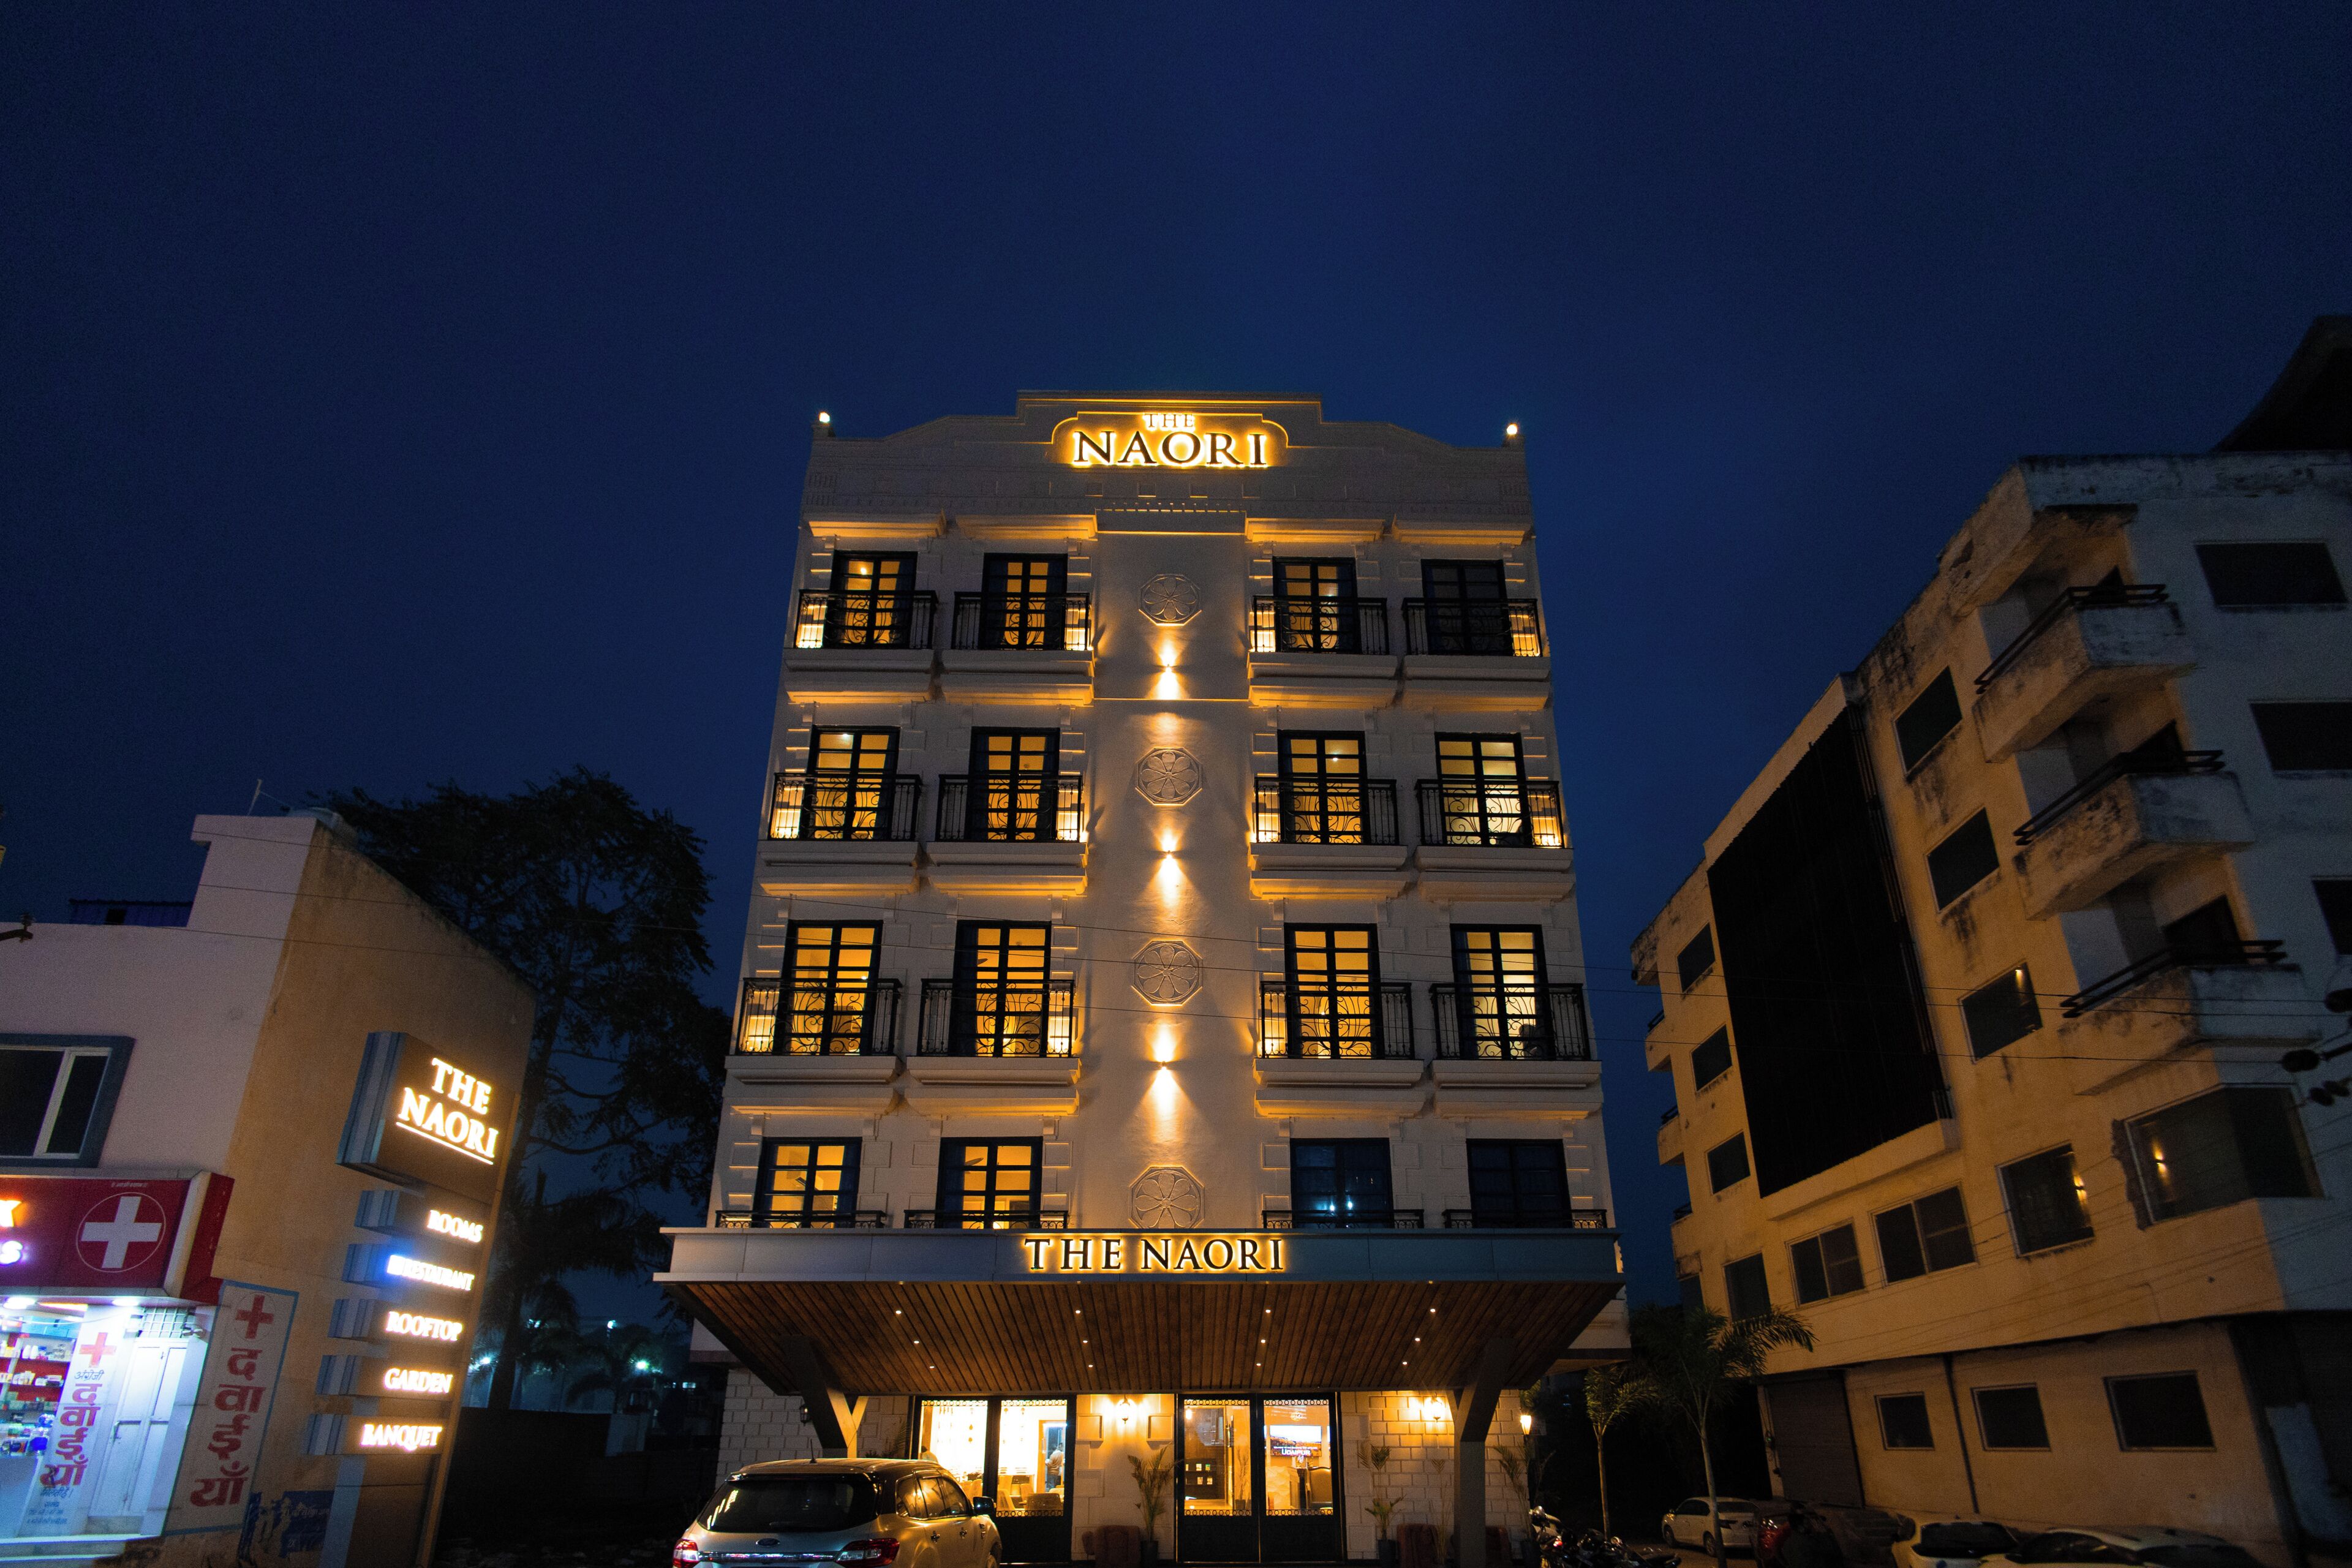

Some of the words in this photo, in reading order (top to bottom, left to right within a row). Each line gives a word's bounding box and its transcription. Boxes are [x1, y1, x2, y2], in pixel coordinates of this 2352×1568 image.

[1143, 412, 1196, 429] THE
[1072, 430, 1268, 467] NAORI
[431, 1057, 492, 1115] THE
[398, 1087, 499, 1158] NAORI
[427, 1209, 484, 1243] ROOMS
[1024, 1238, 1122, 1270] THE
[1140, 1238, 1284, 1270] NAORI
[402, 1258, 475, 1291] RESTAURANT
[385, 1311, 463, 1341] ROOFTOP
[384, 1368, 454, 1393] GARDEN
[360, 1423, 443, 1451] BANQUET
